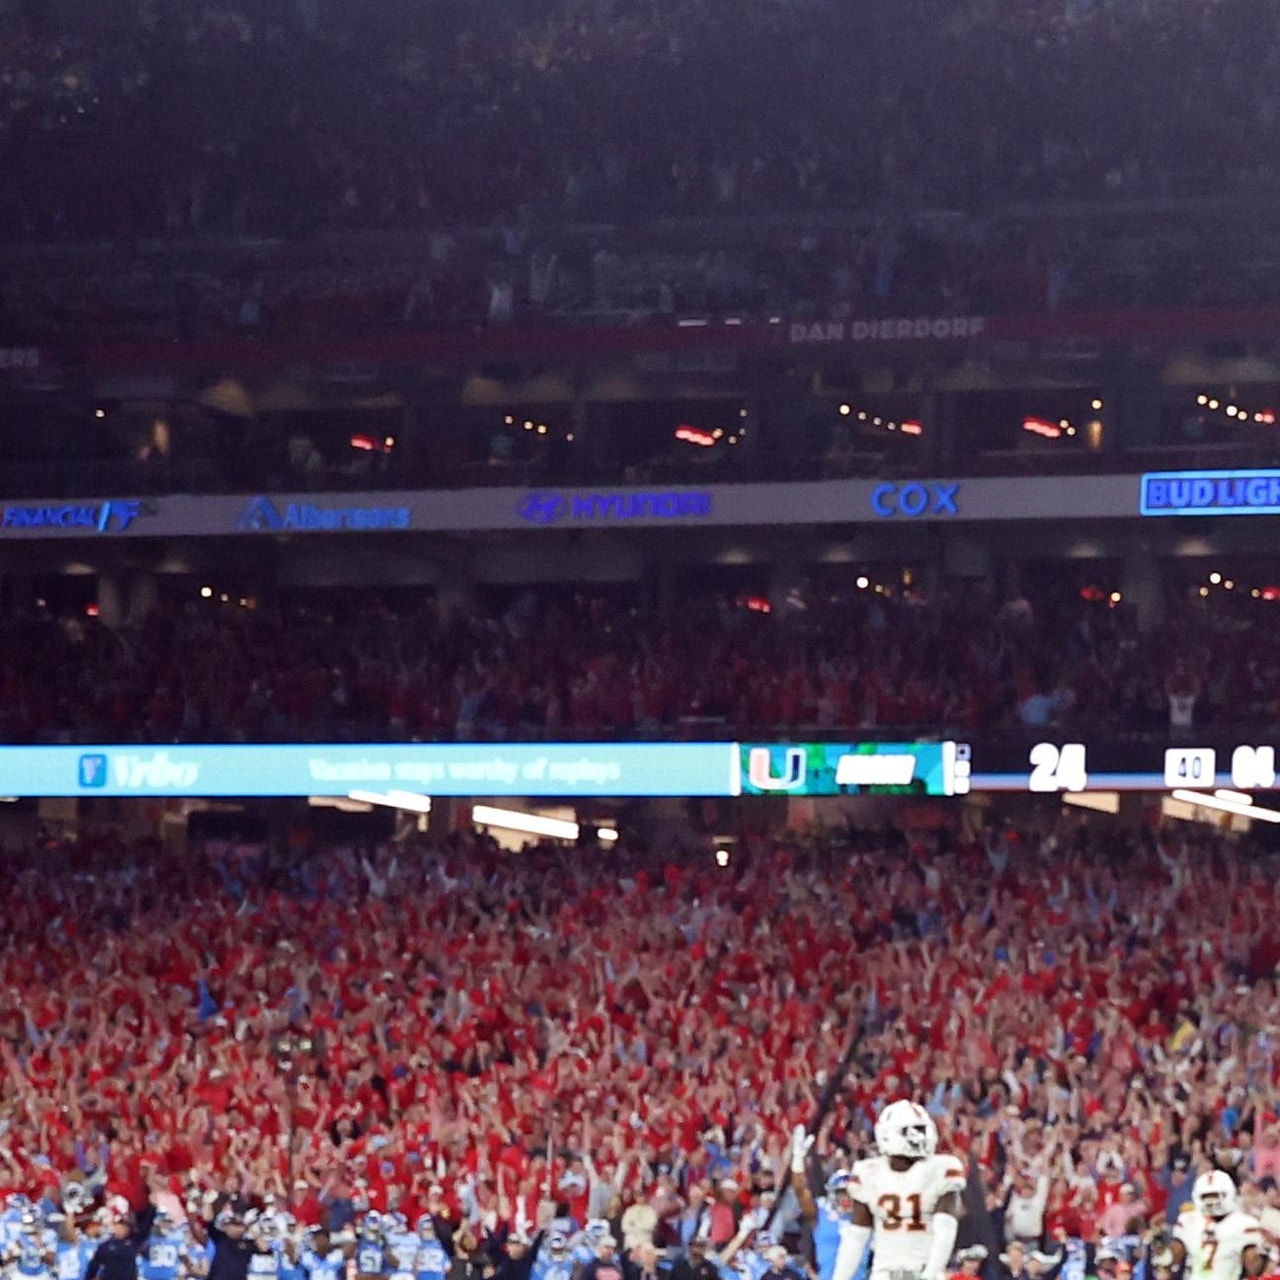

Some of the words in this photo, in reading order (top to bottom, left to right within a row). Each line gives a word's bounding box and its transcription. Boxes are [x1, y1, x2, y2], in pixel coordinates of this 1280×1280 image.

[868, 482, 961, 517] COX
[1147, 478, 1217, 507] BUD
[1028, 742, 1088, 792] 24
[877, 1192, 928, 1232] 31
[1201, 1239, 1219, 1272] 7
